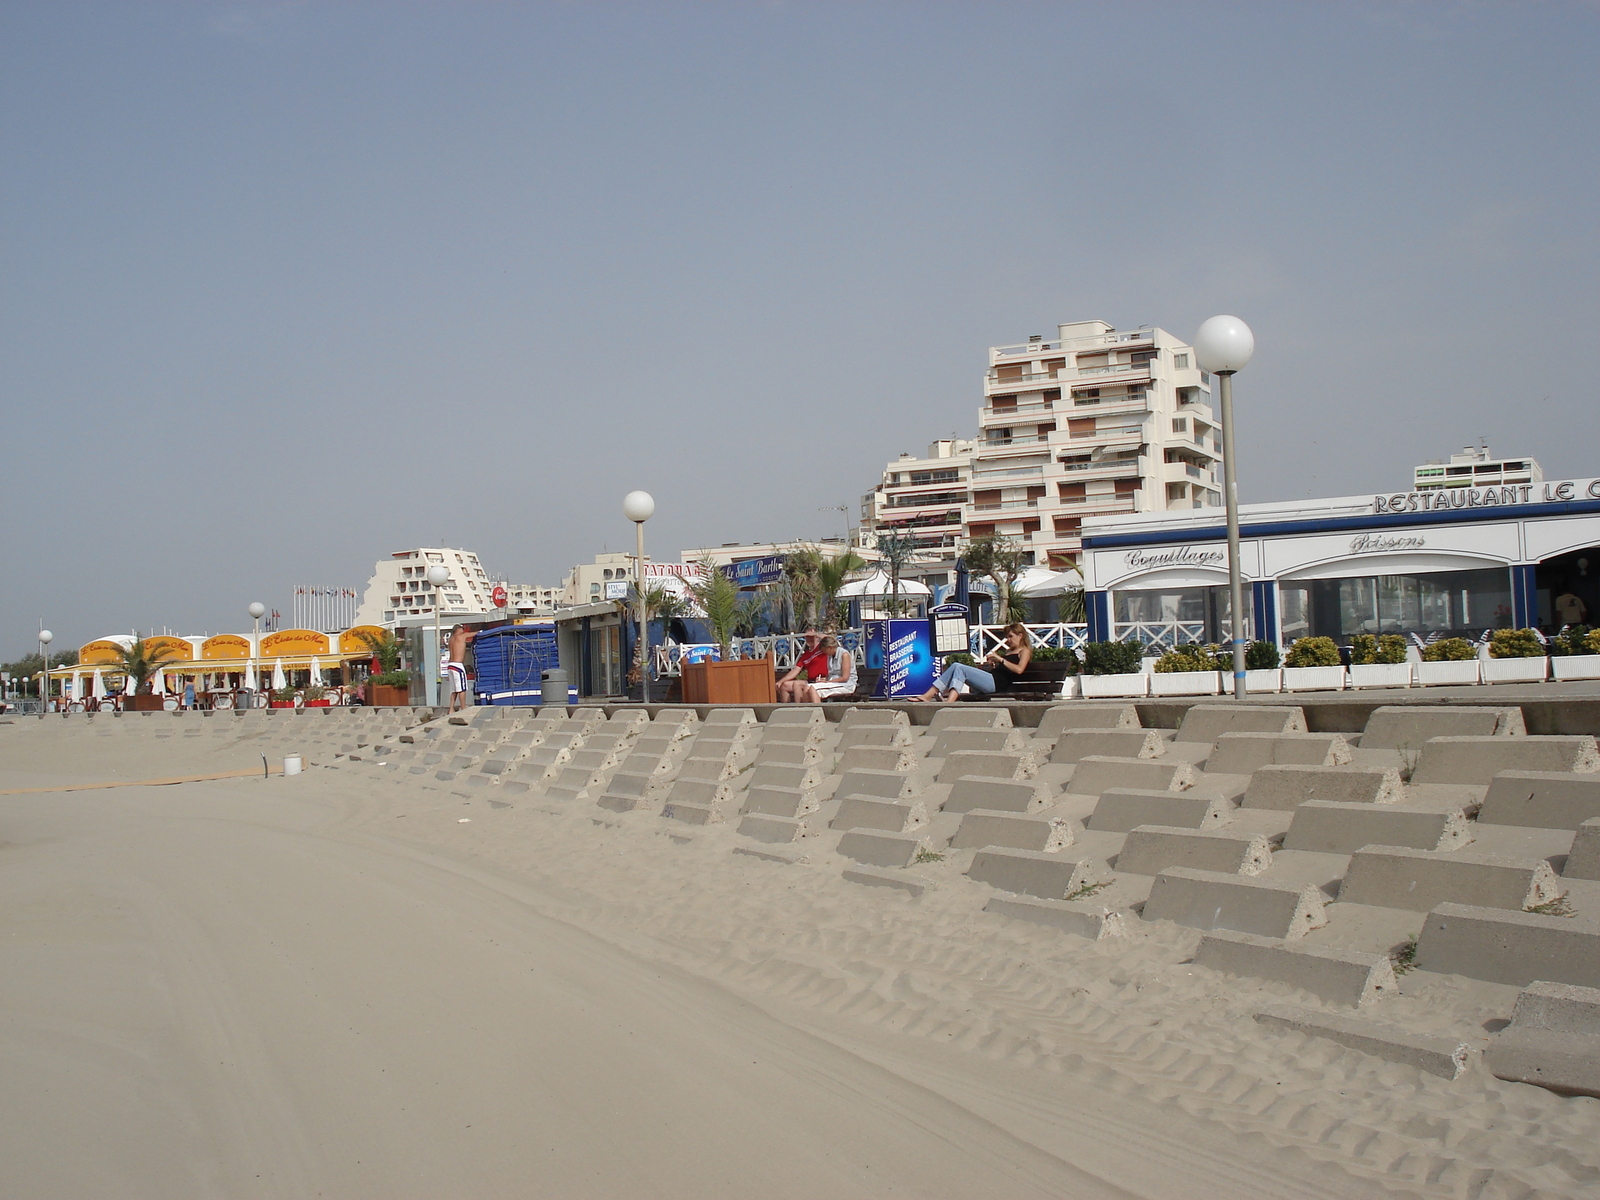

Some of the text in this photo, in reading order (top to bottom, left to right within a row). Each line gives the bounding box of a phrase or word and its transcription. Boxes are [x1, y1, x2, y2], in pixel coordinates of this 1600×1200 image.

[1375, 484, 1533, 513] RESTAURANT
[1544, 481, 1574, 501] LE
[1352, 533, 1425, 553] Poissons
[1126, 546, 1224, 568] Coquillages
[725, 557, 779, 579] Le Saint Barth
[889, 630, 917, 652] RESTAURANT
[889, 643, 914, 663] BRASSERIE
[889, 653, 914, 674] COCKTAILS
[890, 667, 909, 684] GLACIER
[931, 656, 941, 679] Sain
[890, 680, 906, 695] SNACK
